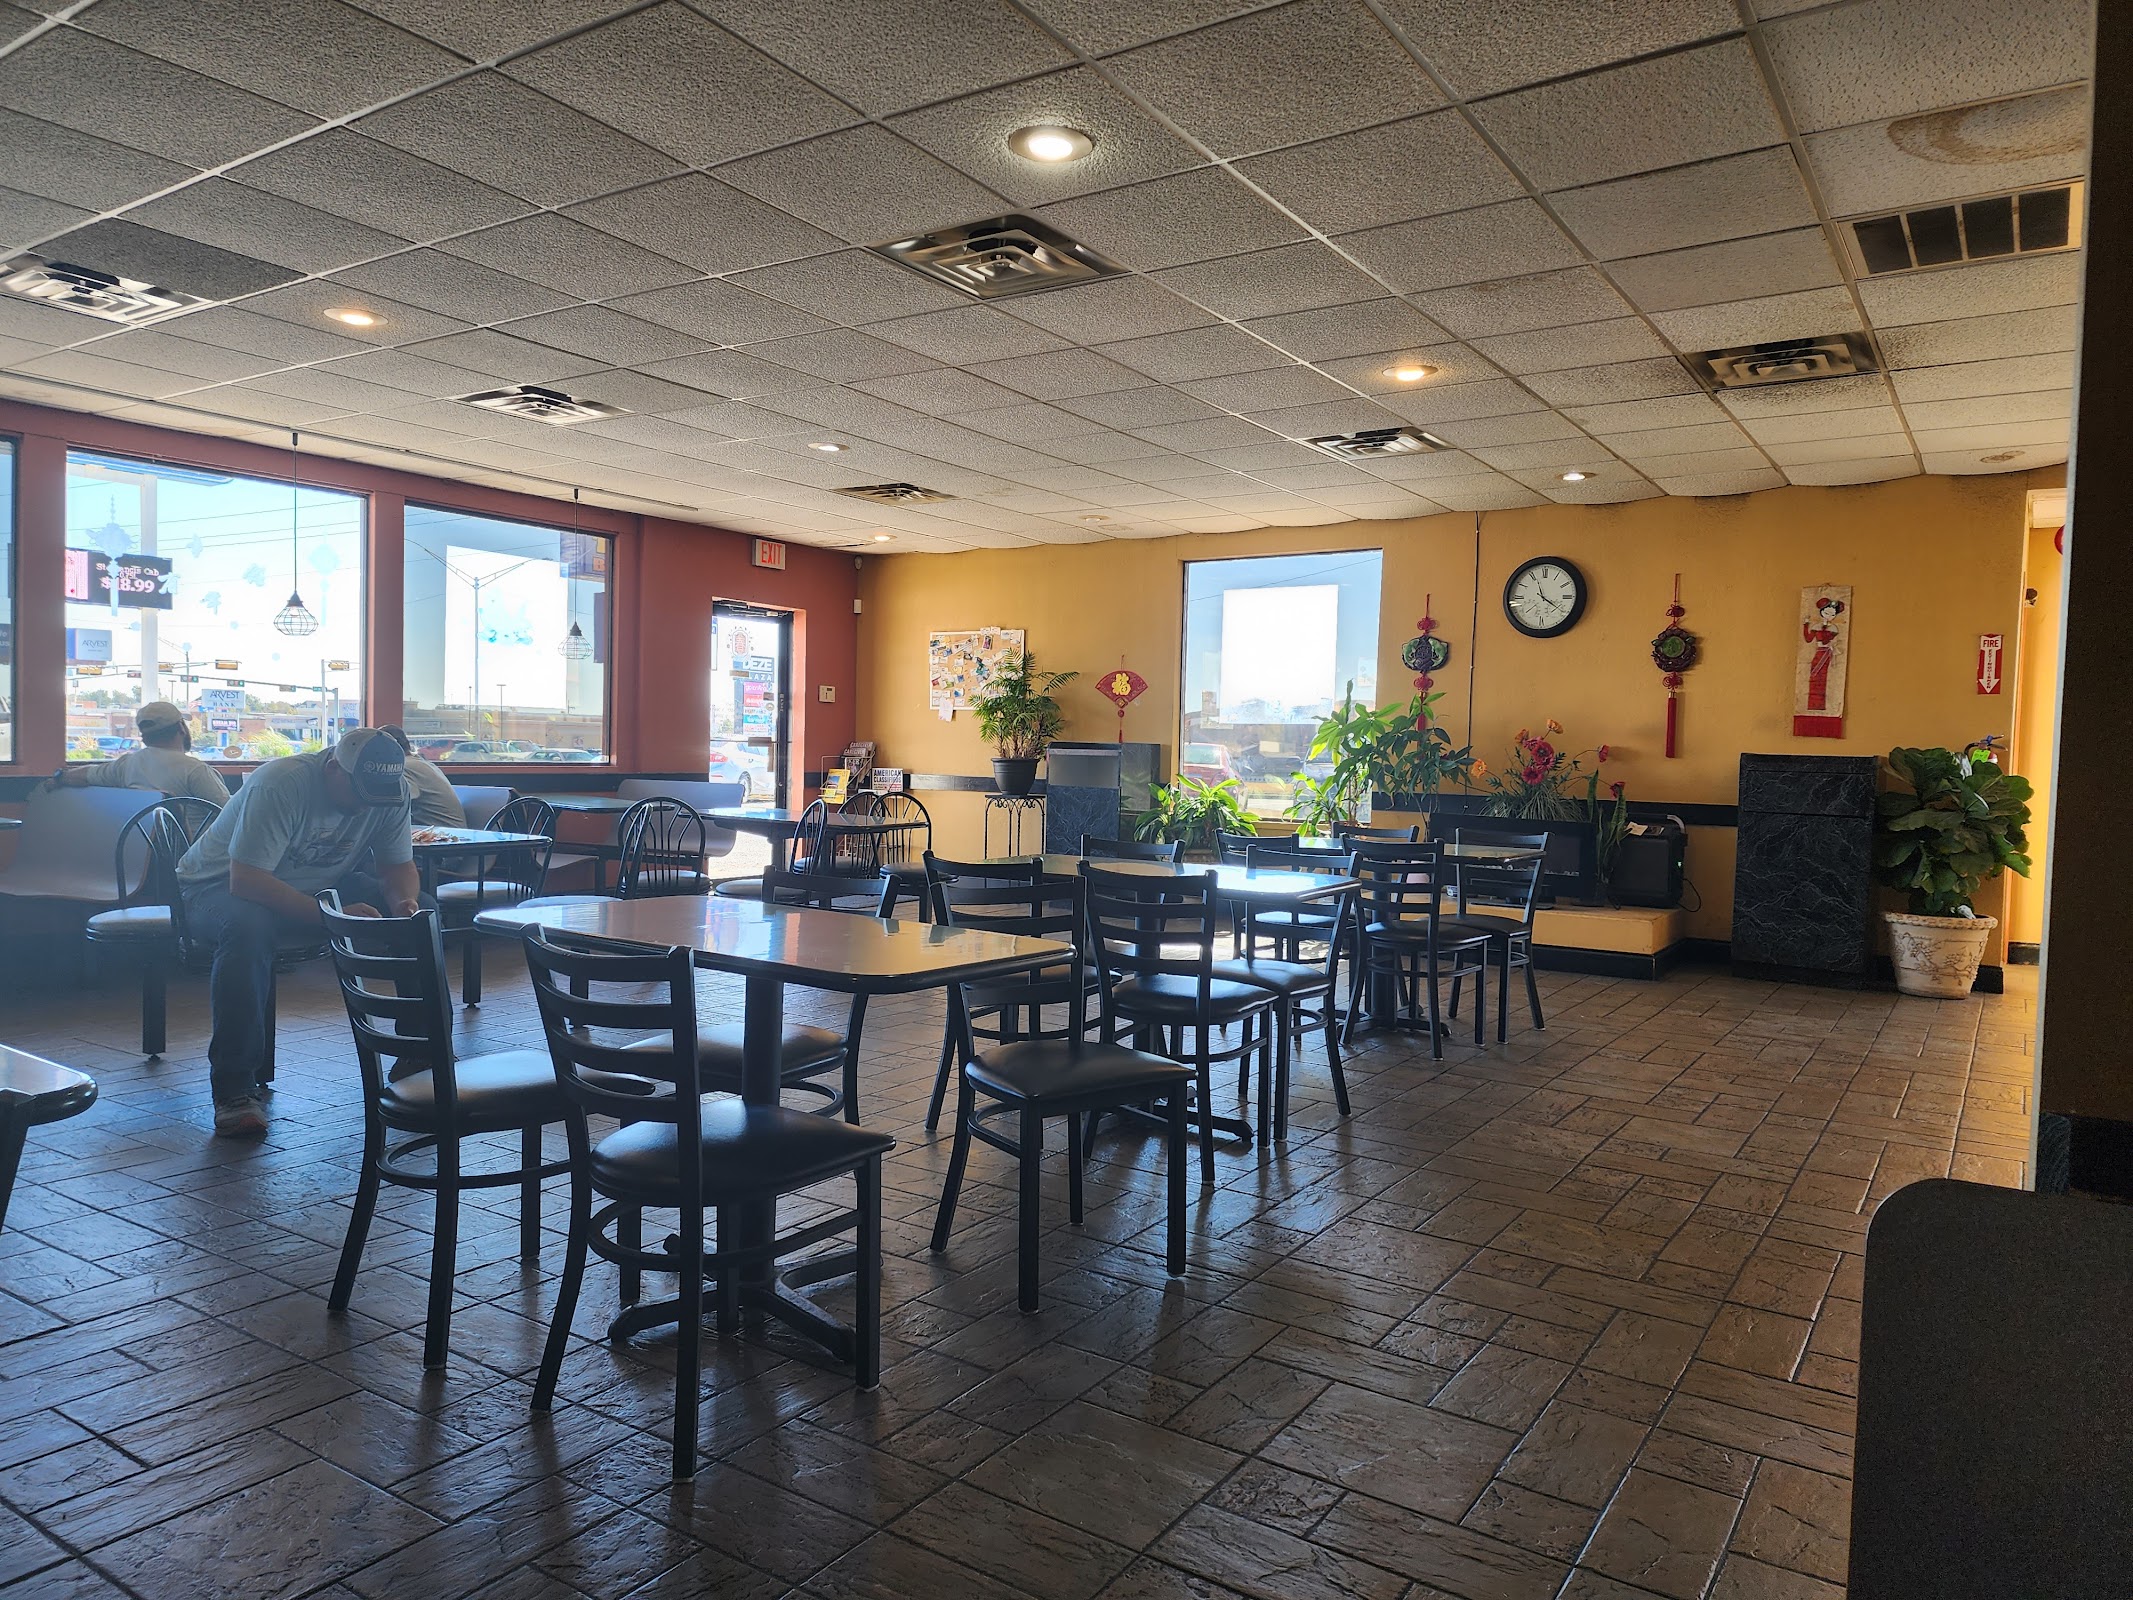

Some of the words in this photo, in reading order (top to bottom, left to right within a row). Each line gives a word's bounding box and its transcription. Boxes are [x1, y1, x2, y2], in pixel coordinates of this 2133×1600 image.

[761, 541, 782, 565] EXIT
[101, 577, 155, 593] $18.99
[82, 640, 108, 648] ARVEST
[1983, 639, 1999, 647] FIRE
[210, 690, 240, 701] ARVEST
